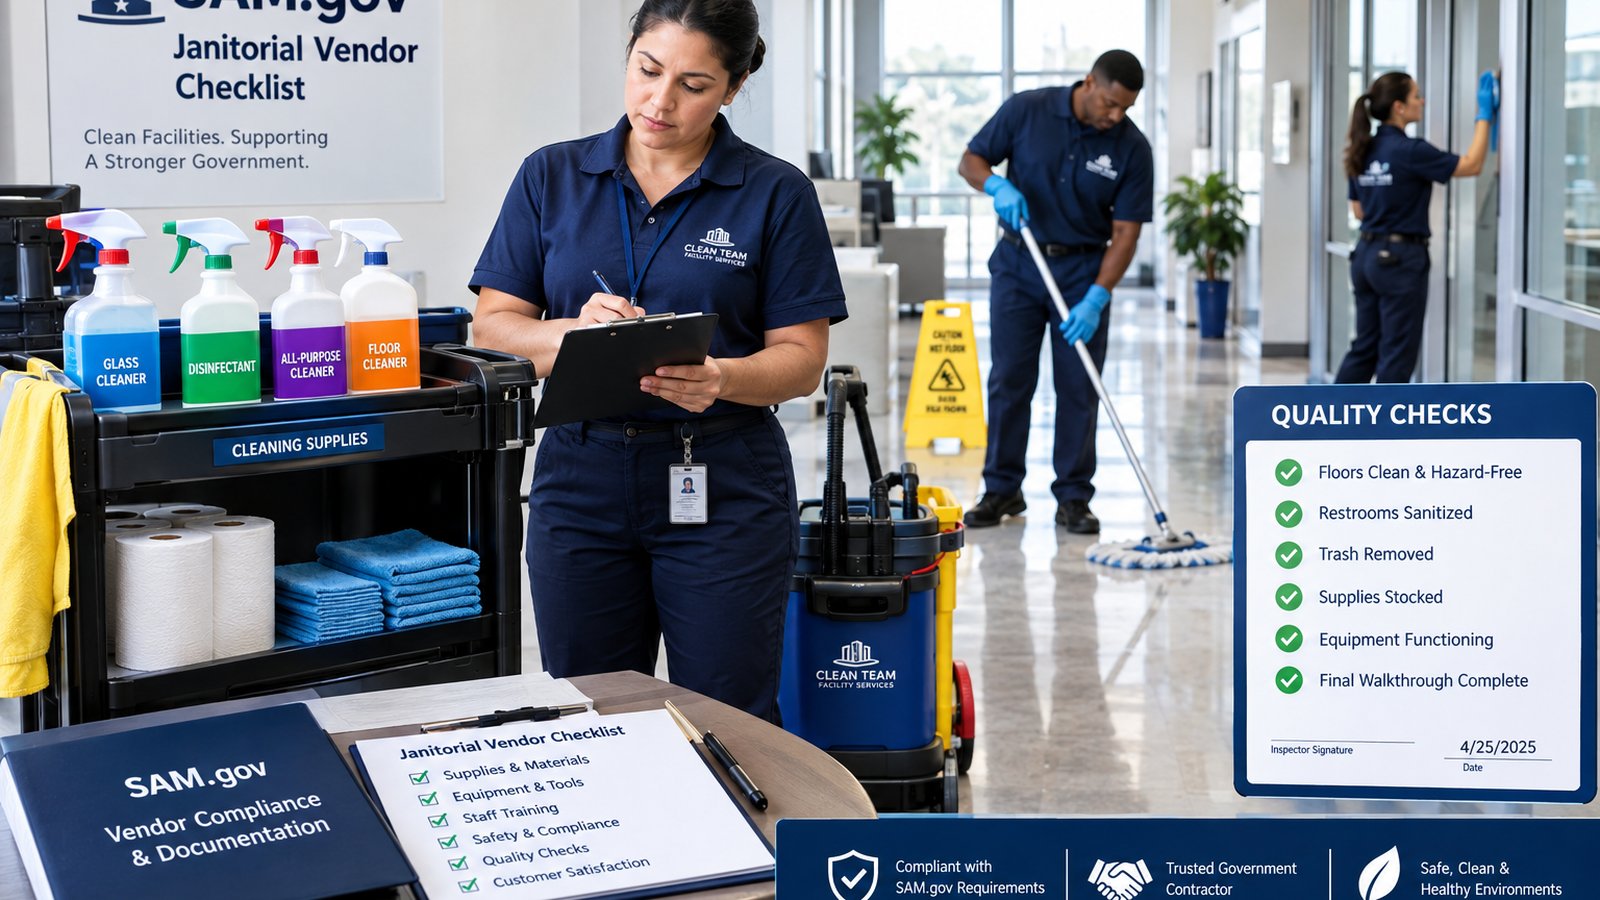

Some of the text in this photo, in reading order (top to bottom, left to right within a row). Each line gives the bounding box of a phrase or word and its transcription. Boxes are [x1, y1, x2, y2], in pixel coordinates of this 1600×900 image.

[174, 34, 418, 63] Janitorial Vendor
[176, 73, 305, 100] Checklist
[84, 128, 327, 148] Clean Facilities. Supporting
[85, 154, 308, 173] A Stronger Government.
[684, 244, 747, 260] CLEAN TEAM
[281, 350, 340, 364] ALL-PURPOSE
[369, 343, 400, 354] FLOOR
[104, 357, 139, 370] GLASS
[189, 360, 256, 375] DISINFECTANT
[291, 366, 334, 378] CLEANER
[363, 357, 407, 369] CLEANER
[97, 373, 146, 386] CLEANER
[232, 432, 367, 457] CLEANING SUPPLIES
[816, 670, 896, 680] CLEAN TEAM
[401, 726, 625, 759] Janitorial Vendor Checklist
[444, 755, 590, 780] Supplies & Materials
[125, 762, 266, 797] SAM.gov
[453, 778, 584, 802] Equipment & Tools
[104, 794, 322, 842] Vendor Compliance
[463, 805, 559, 823] Staff Training
[132, 817, 331, 866] & Documentation
[473, 820, 619, 844] Safety & Compliance
[483, 844, 589, 866] Quality Checks
[494, 859, 650, 887] Customer Satisfaction
